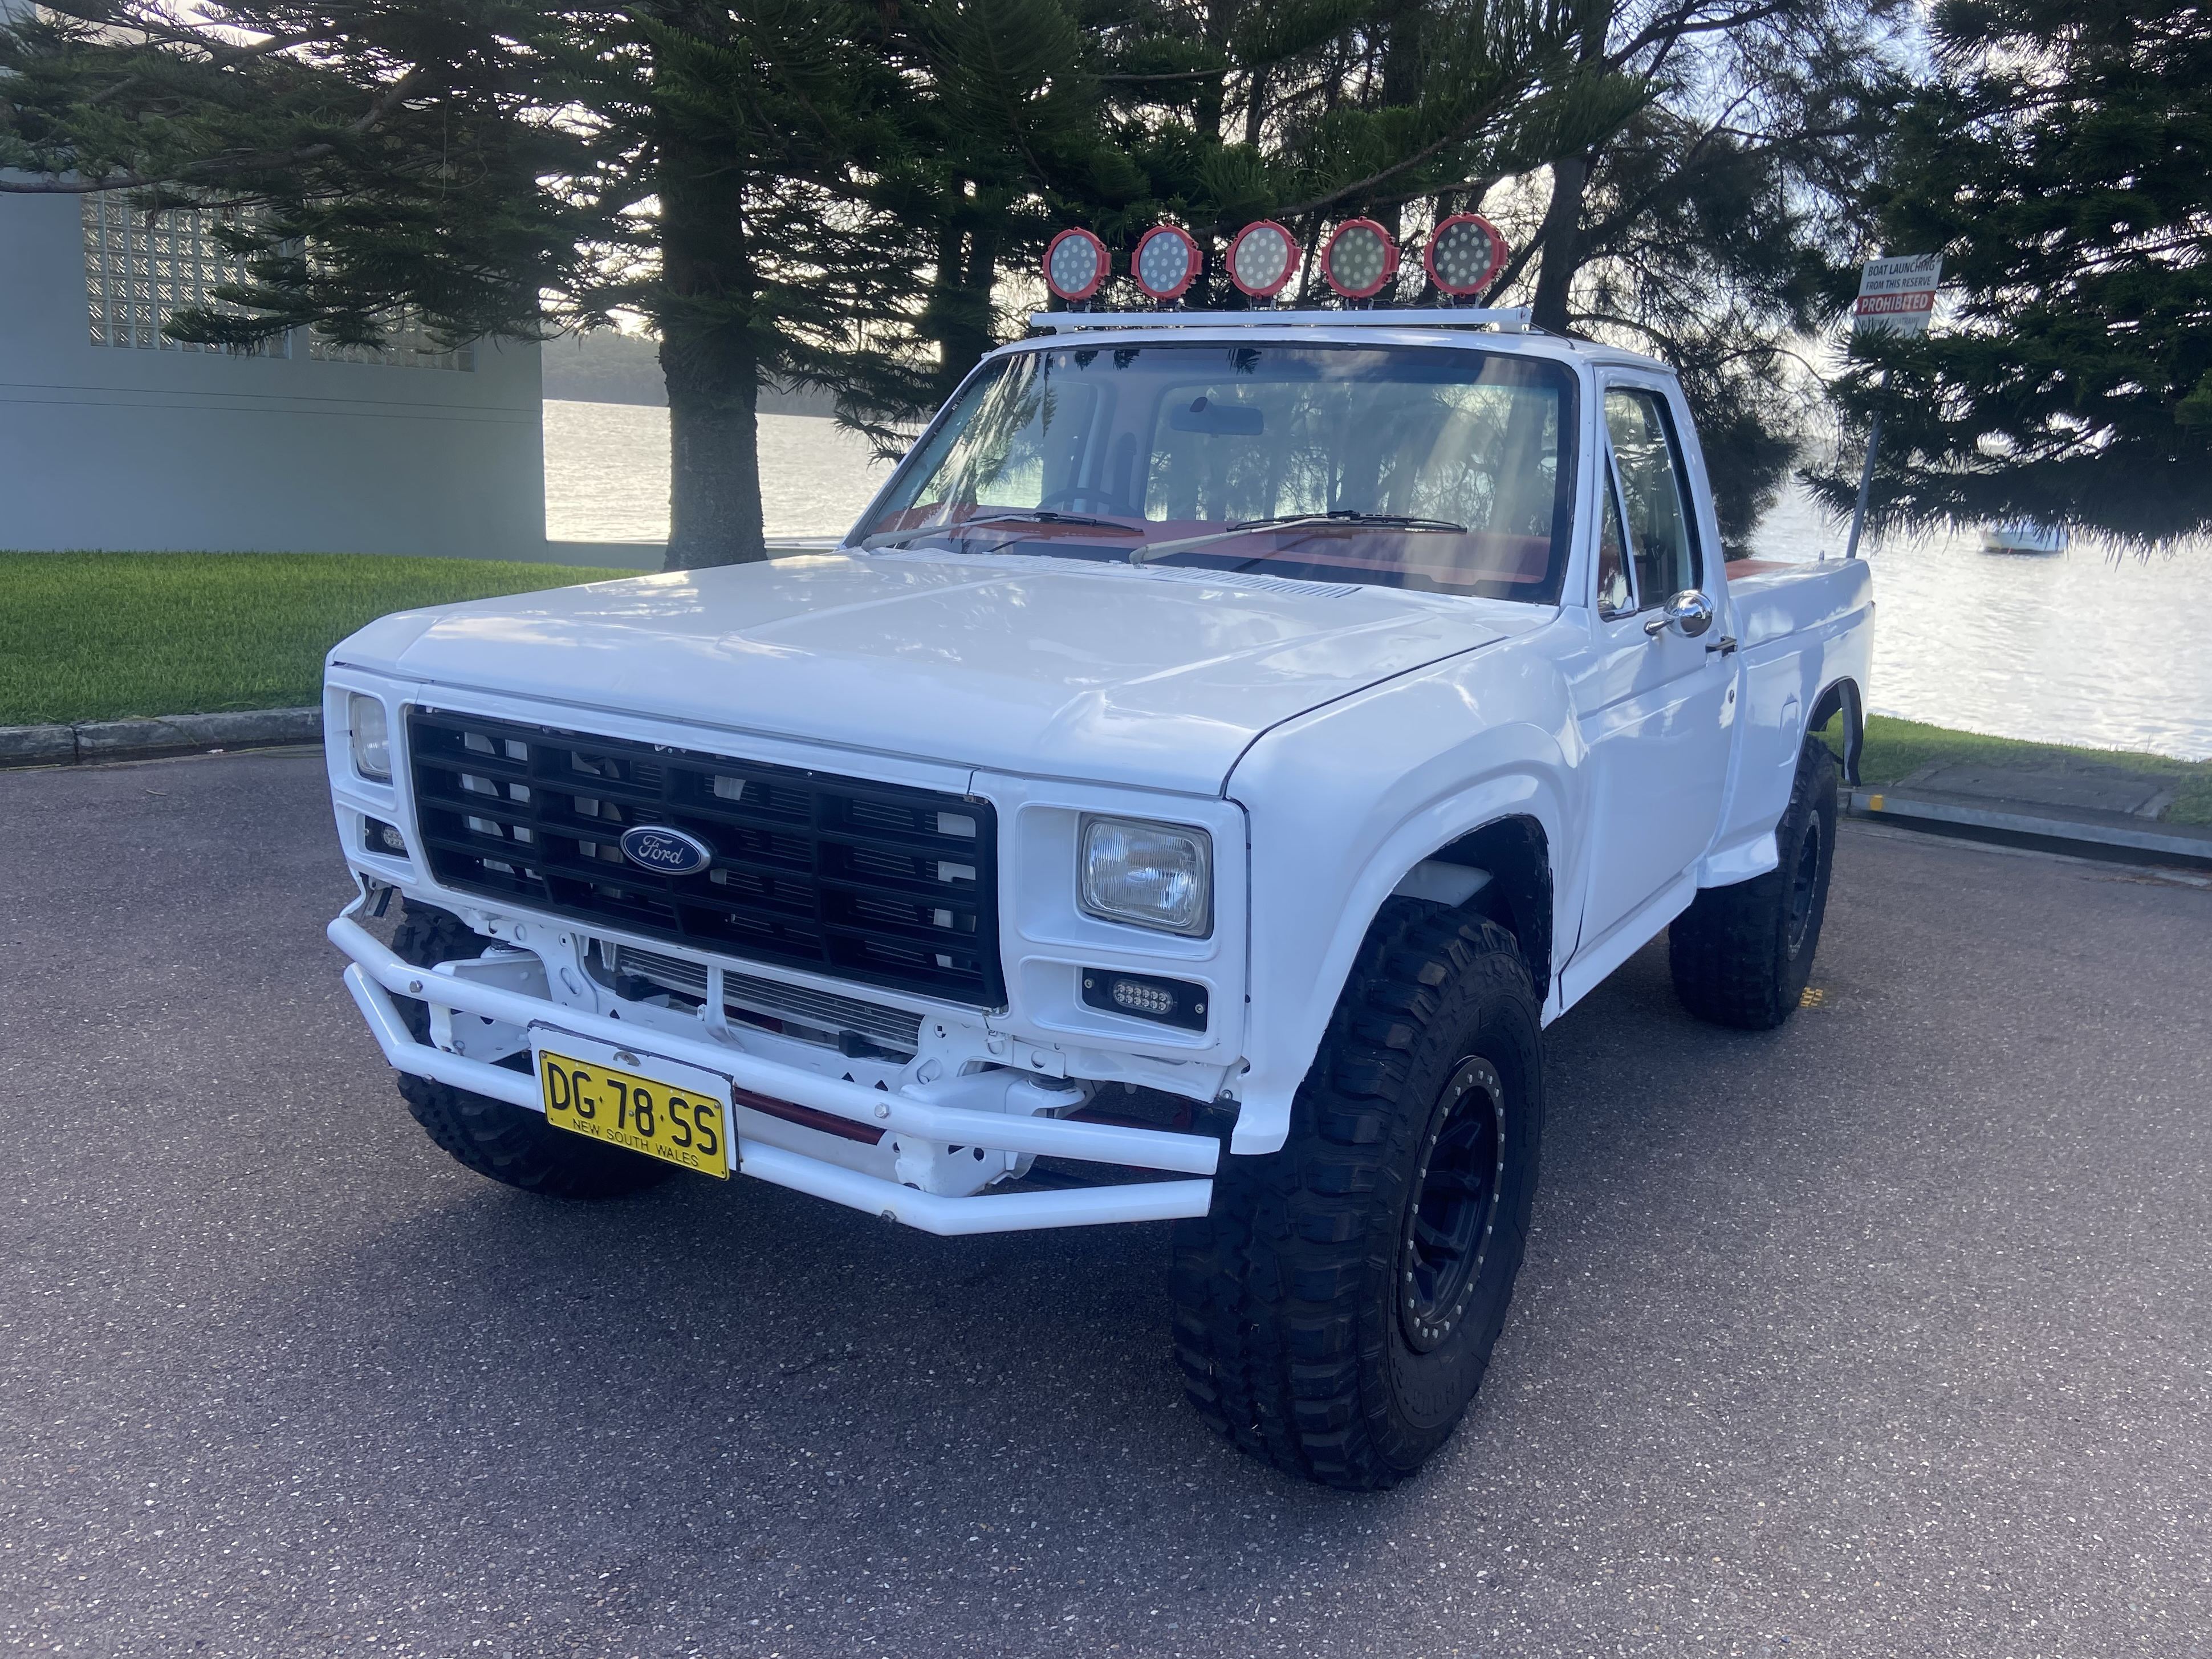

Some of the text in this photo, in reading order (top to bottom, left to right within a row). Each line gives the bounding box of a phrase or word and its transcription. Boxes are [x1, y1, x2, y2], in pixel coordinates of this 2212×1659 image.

[1868, 260, 1936, 276] BOAT LAUNCHING
[1865, 276, 1932, 291] FROM THIS RESERVE
[1861, 294, 1928, 313] PROHIBITED
[639, 835, 684, 864] Ford
[572, 1118, 699, 1167] NEW SOUTH WALES
